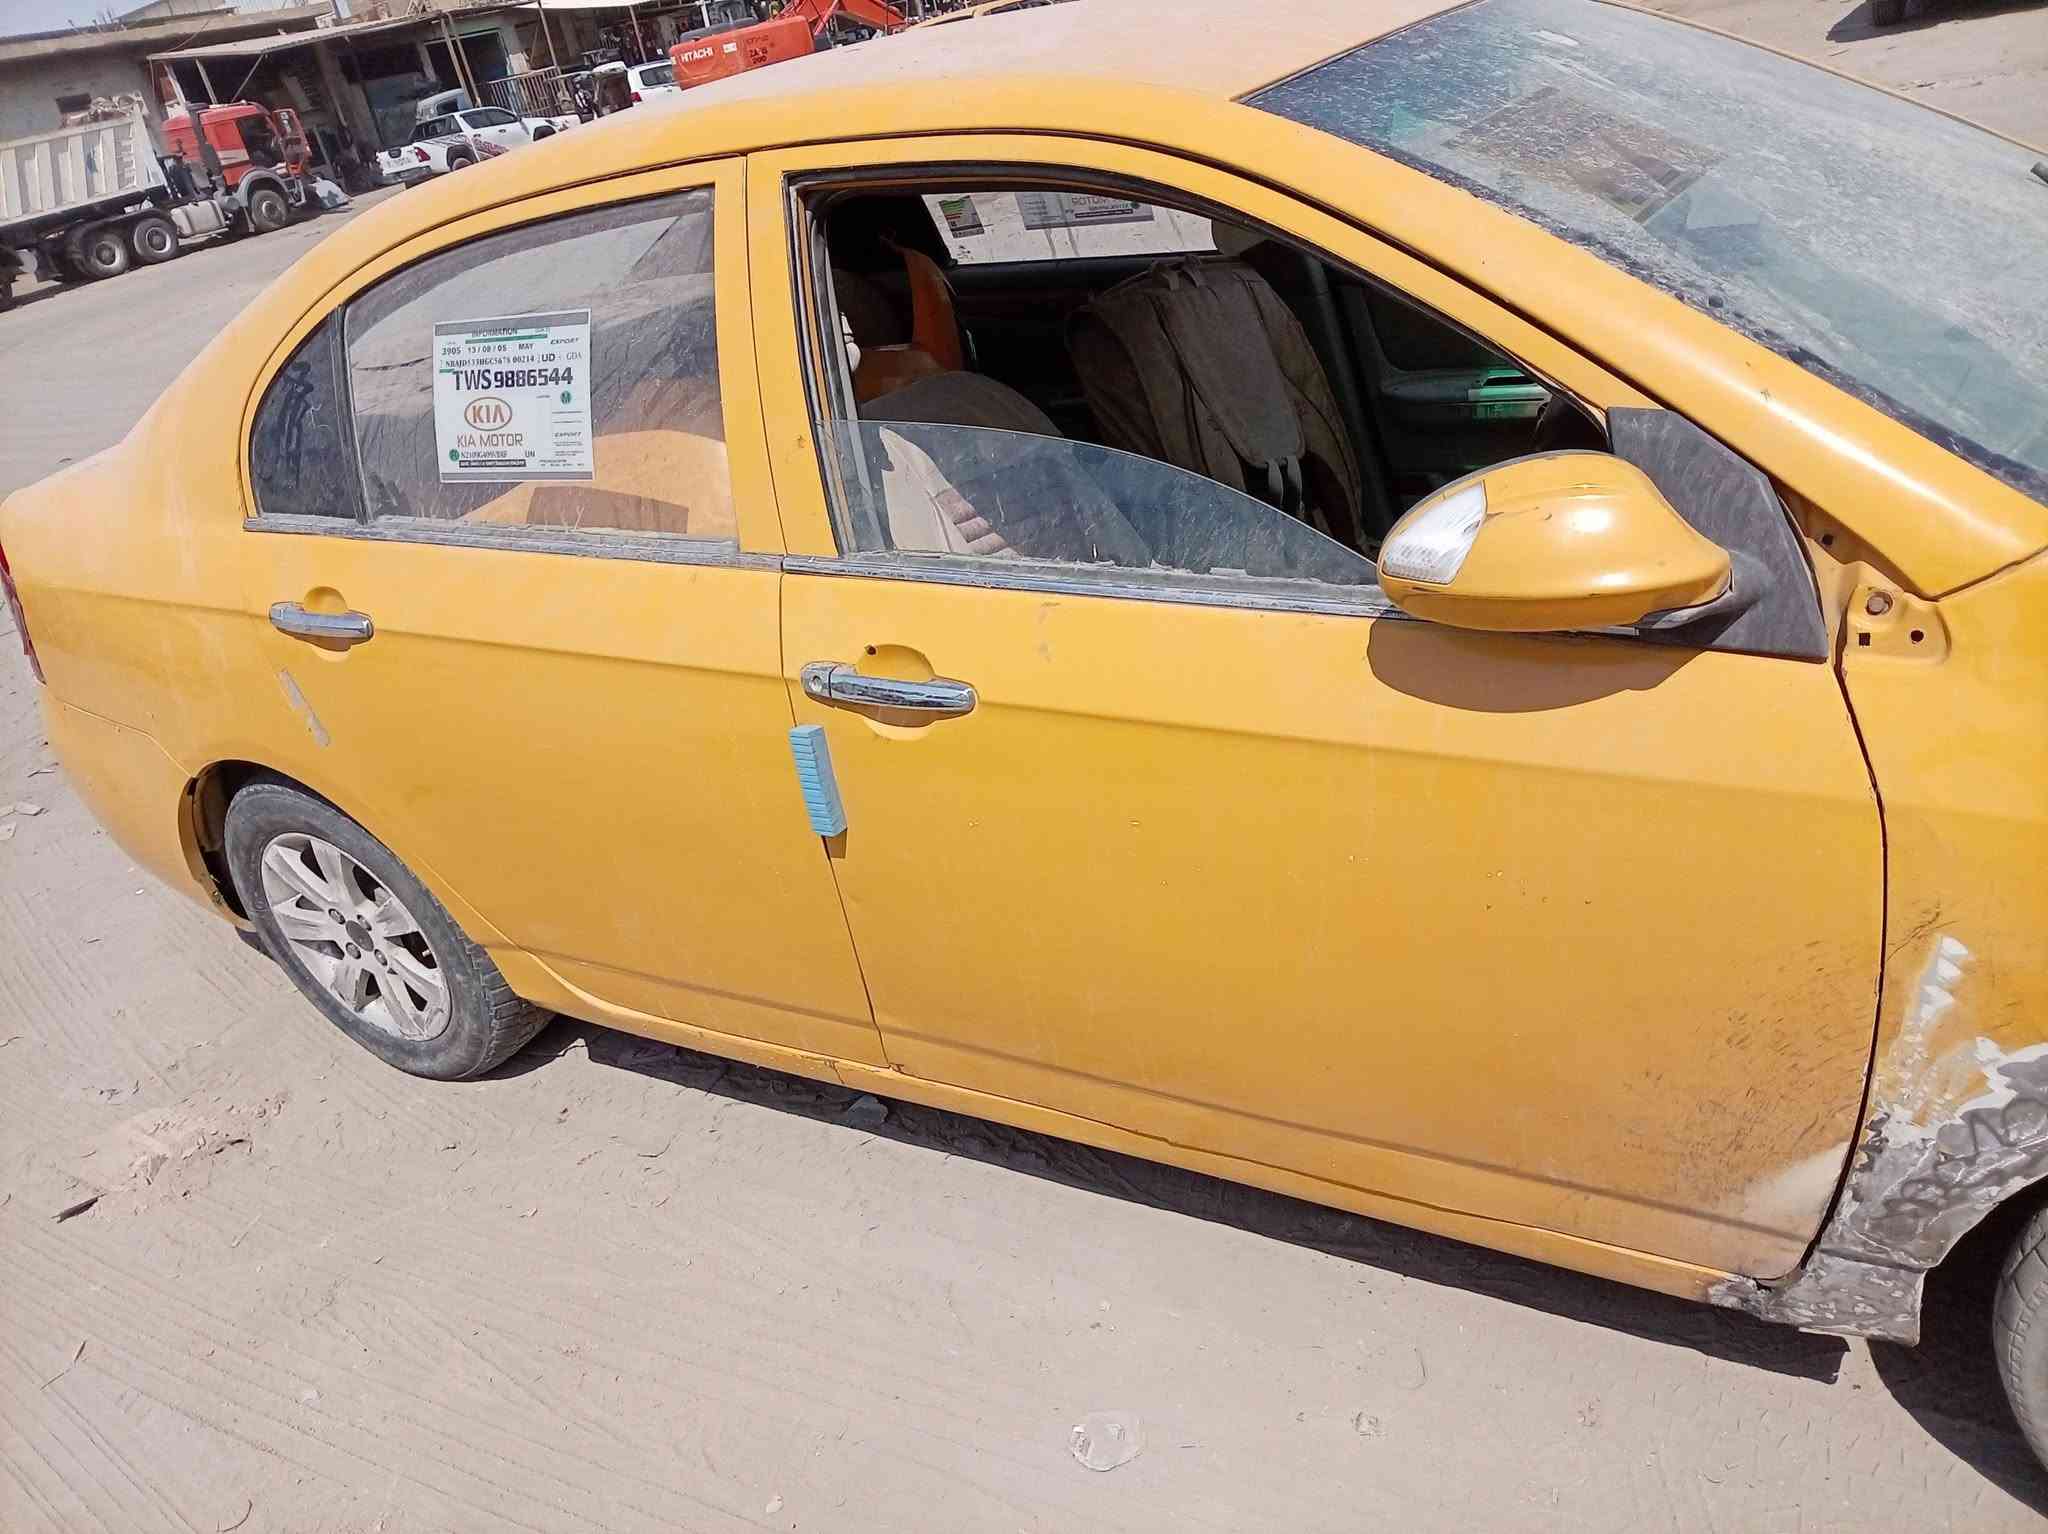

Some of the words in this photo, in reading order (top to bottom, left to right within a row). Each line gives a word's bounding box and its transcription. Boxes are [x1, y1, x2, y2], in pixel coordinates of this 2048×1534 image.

[681, 47, 714, 63] HITACHI
[541, 353, 556, 362] UD
[452, 366, 574, 391] TWS9886544
[471, 404, 505, 424] KIA
[456, 433, 478, 448] KIA
[479, 432, 523, 447] MOTOR
